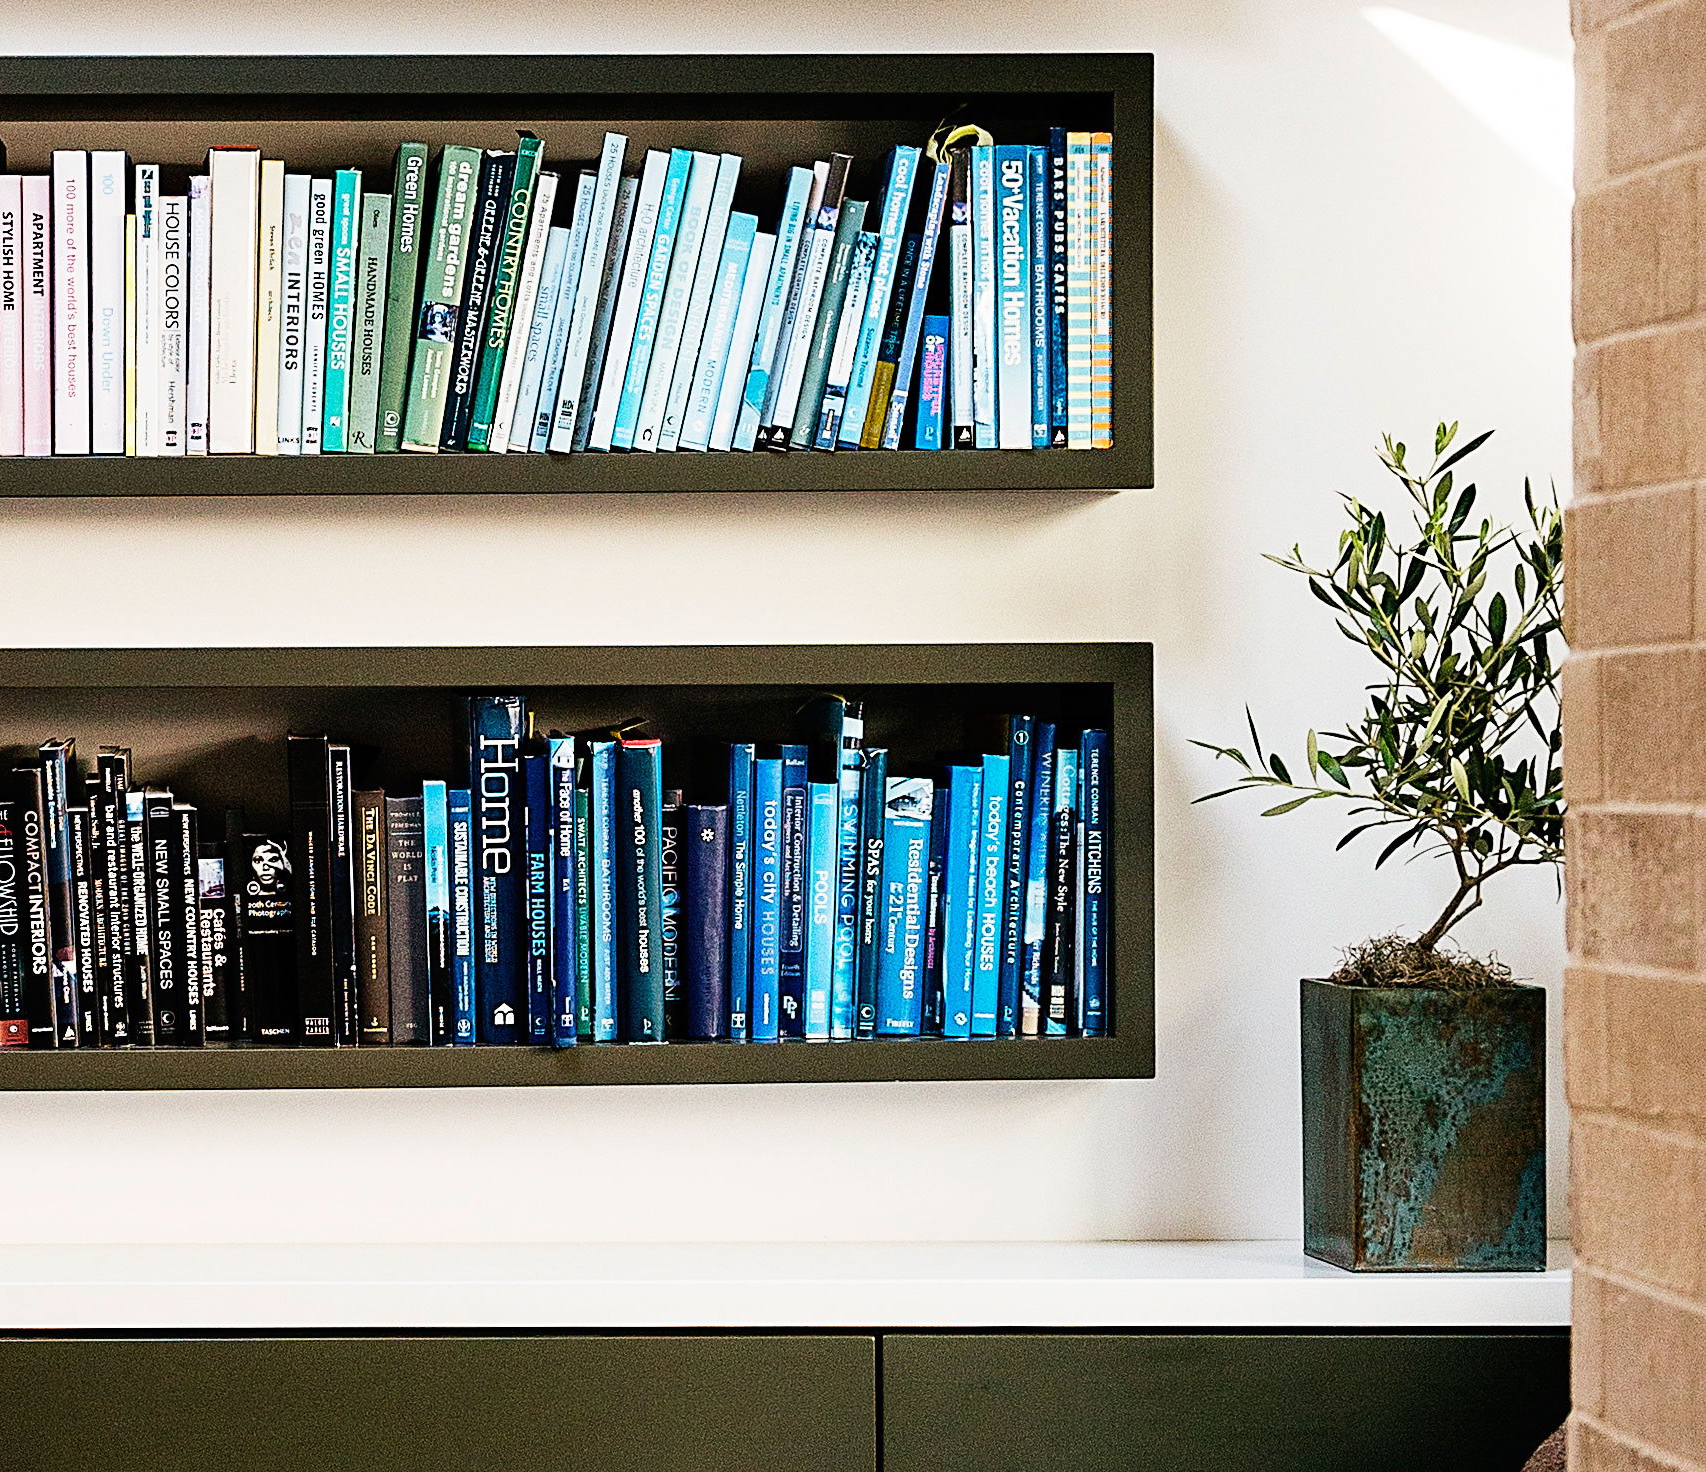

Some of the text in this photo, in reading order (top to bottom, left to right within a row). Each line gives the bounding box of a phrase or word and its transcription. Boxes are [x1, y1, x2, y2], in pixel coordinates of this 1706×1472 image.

[400, 157, 423, 253] Green Homes
[442, 162, 473, 297] dream gardens
[1054, 157, 1064, 200] BARS
[1054, 211, 1064, 253] PUBS
[32, 213, 45, 371] APARTMENT INTERIORS
[66, 179, 79, 398] 100 more of the world's best houses
[165, 203, 180, 329] HOUSE COLORS
[312, 194, 326, 320] good green HOMES
[361, 257, 378, 375] HANDMADE HOUSES
[105, 805, 116, 823] bar
[107, 826, 118, 847] and
[480, 735, 519, 874] Home
[559, 783, 572, 808] Face
[560, 811, 573, 821] of
[560, 825, 573, 857] Home
[25, 811, 47, 974] COMPACT INTERIORS
[108, 850, 119, 909] restaurant
[155, 840, 172, 989] NEW SMALL SPACES
[454, 822, 470, 955] SUSTAINABLE CONSTRUCTION
[531, 854, 545, 956] FARM HOUSES
[633, 789, 650, 973] another 100 of the world's best houses
[734, 790, 746, 929] Nettleton The Simple Home
[762, 800, 778, 974] today's city HOUSES
[815, 870, 829, 924] POOLS
[839, 804, 857, 969] SWIMMING POOL
[901, 838, 923, 999] Residential Designs
[980, 796, 1002, 970] today's beach HOUSES
[1007, 781, 1025, 964] Contemporary Architecture
[1088, 830, 1101, 893] KITCHENS
[77, 881, 93, 992] RENOVATED HOUSES
[112, 954, 124, 1008] structures
[184, 879, 199, 1005] NEW COUNTRY HOUSES
[200, 909, 215, 996] Restaurants
[214, 909, 227, 966] Cafés &
